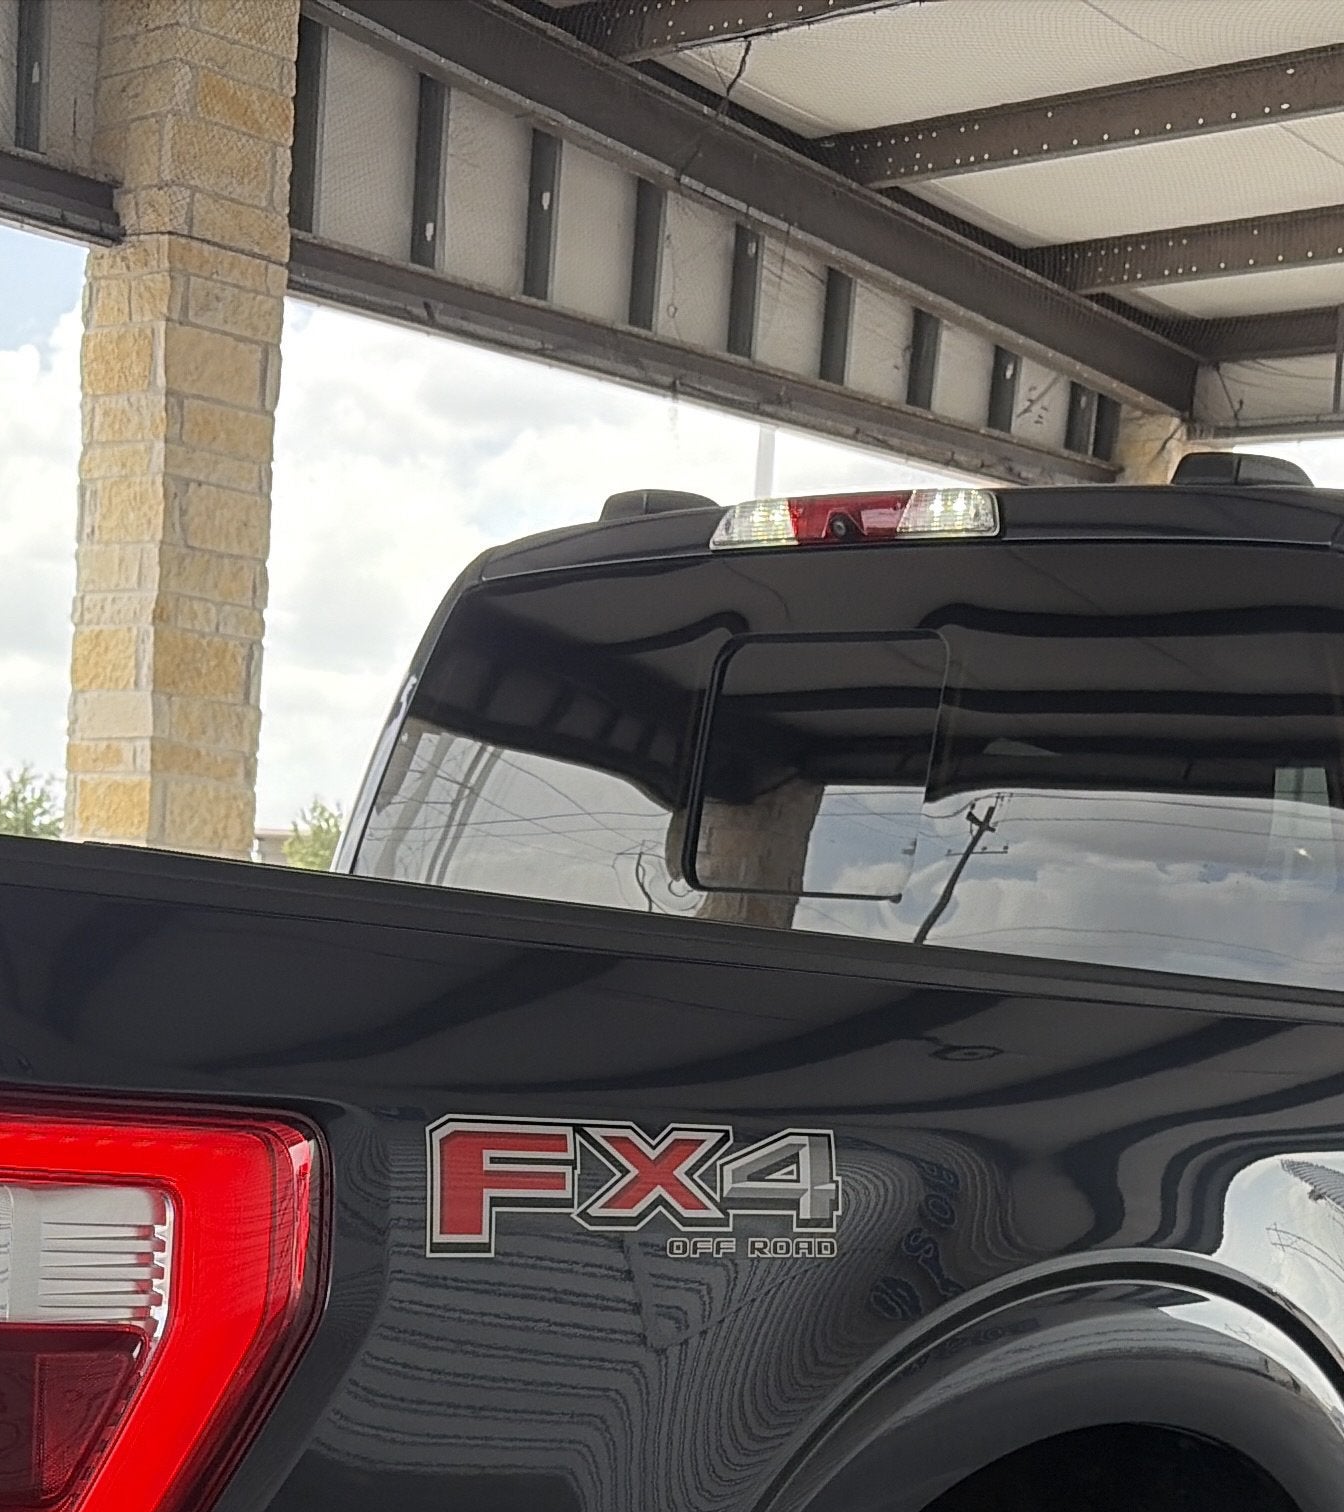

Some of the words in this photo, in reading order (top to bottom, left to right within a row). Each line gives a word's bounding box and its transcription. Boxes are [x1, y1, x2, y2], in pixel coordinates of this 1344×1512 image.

[426, 1113, 843, 1258] FX4
[666, 1237, 737, 1258] OFF
[747, 1237, 838, 1259] ROAD
